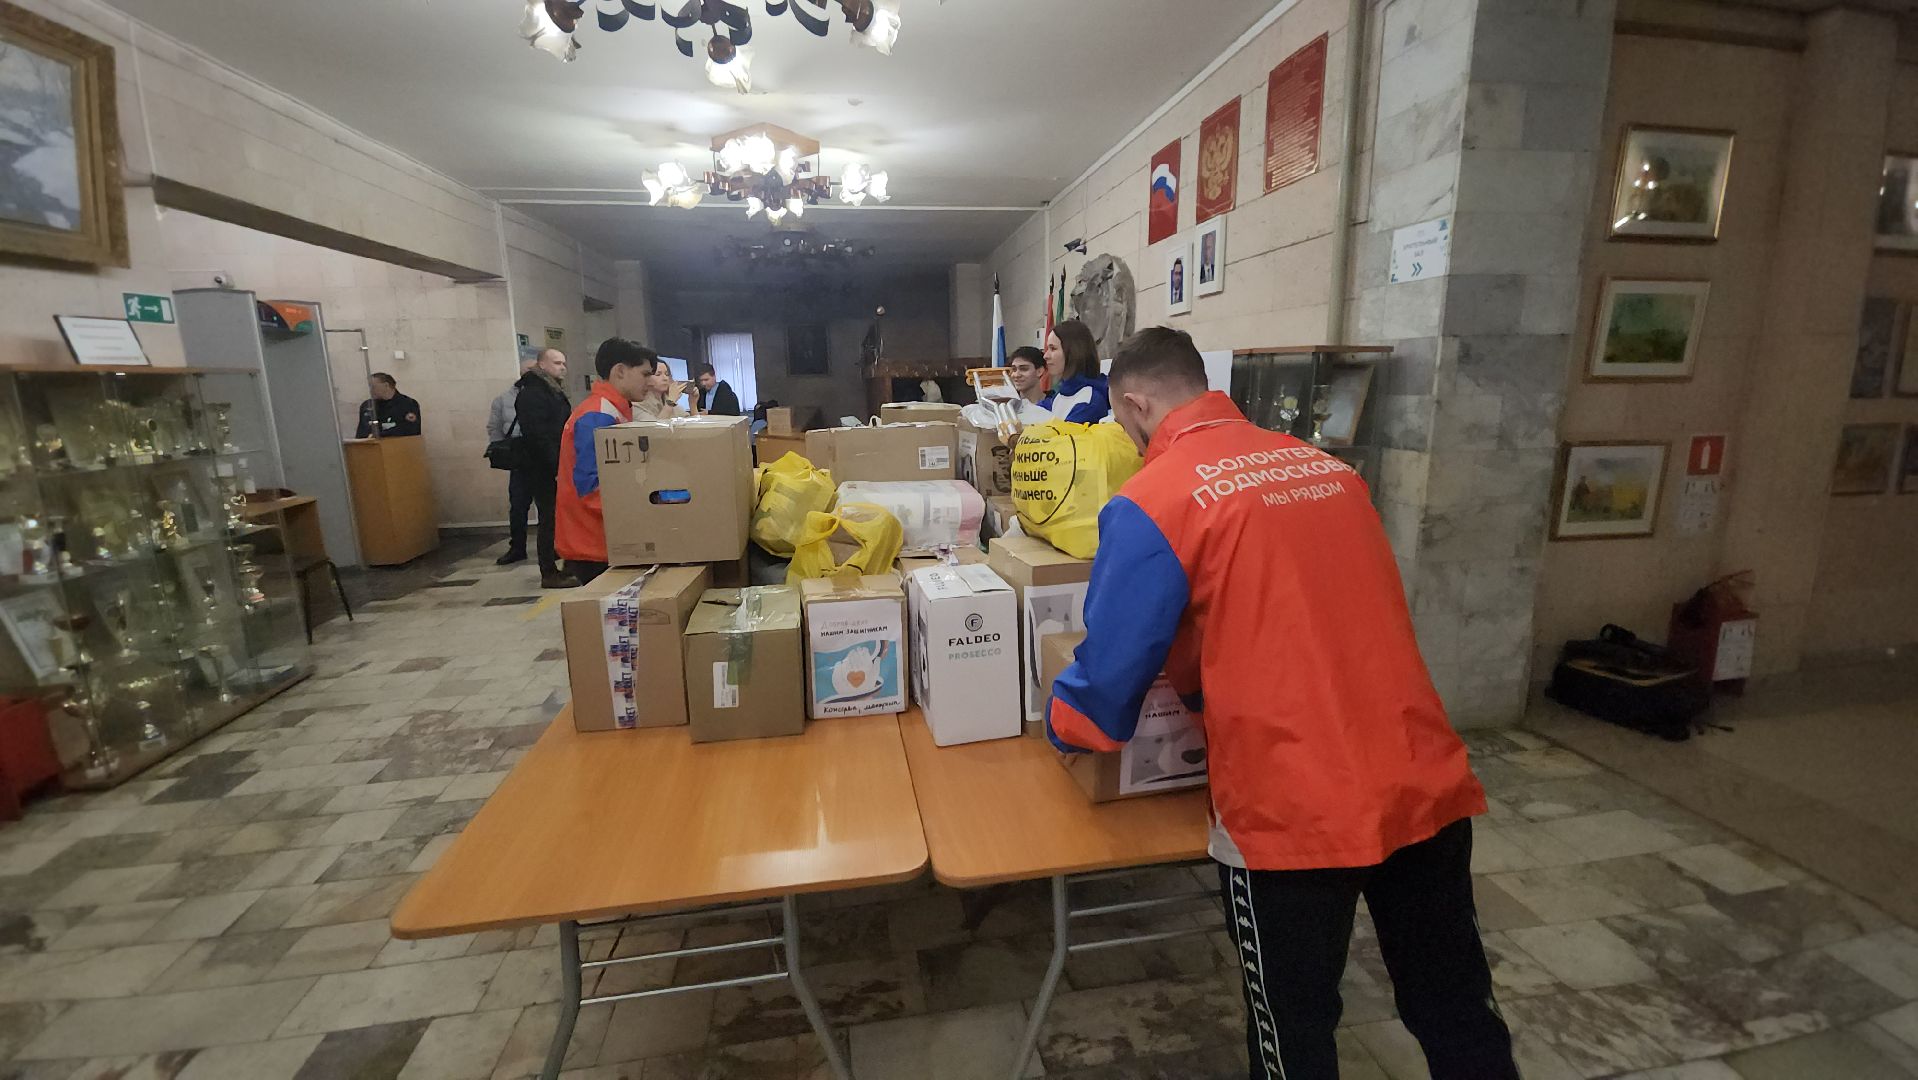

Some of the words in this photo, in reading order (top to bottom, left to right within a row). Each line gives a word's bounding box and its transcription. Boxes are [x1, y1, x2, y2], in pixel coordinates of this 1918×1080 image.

[1016, 451, 1060, 465] жного,
[1192, 459, 1357, 509] ПОДМОСКОВЬ
[1262, 491, 1291, 507] МЫ
[1292, 481, 1346, 501] РЯДОМ
[948, 632, 1001, 647] FALDEO
[948, 647, 1002, 660] PROSECCO
